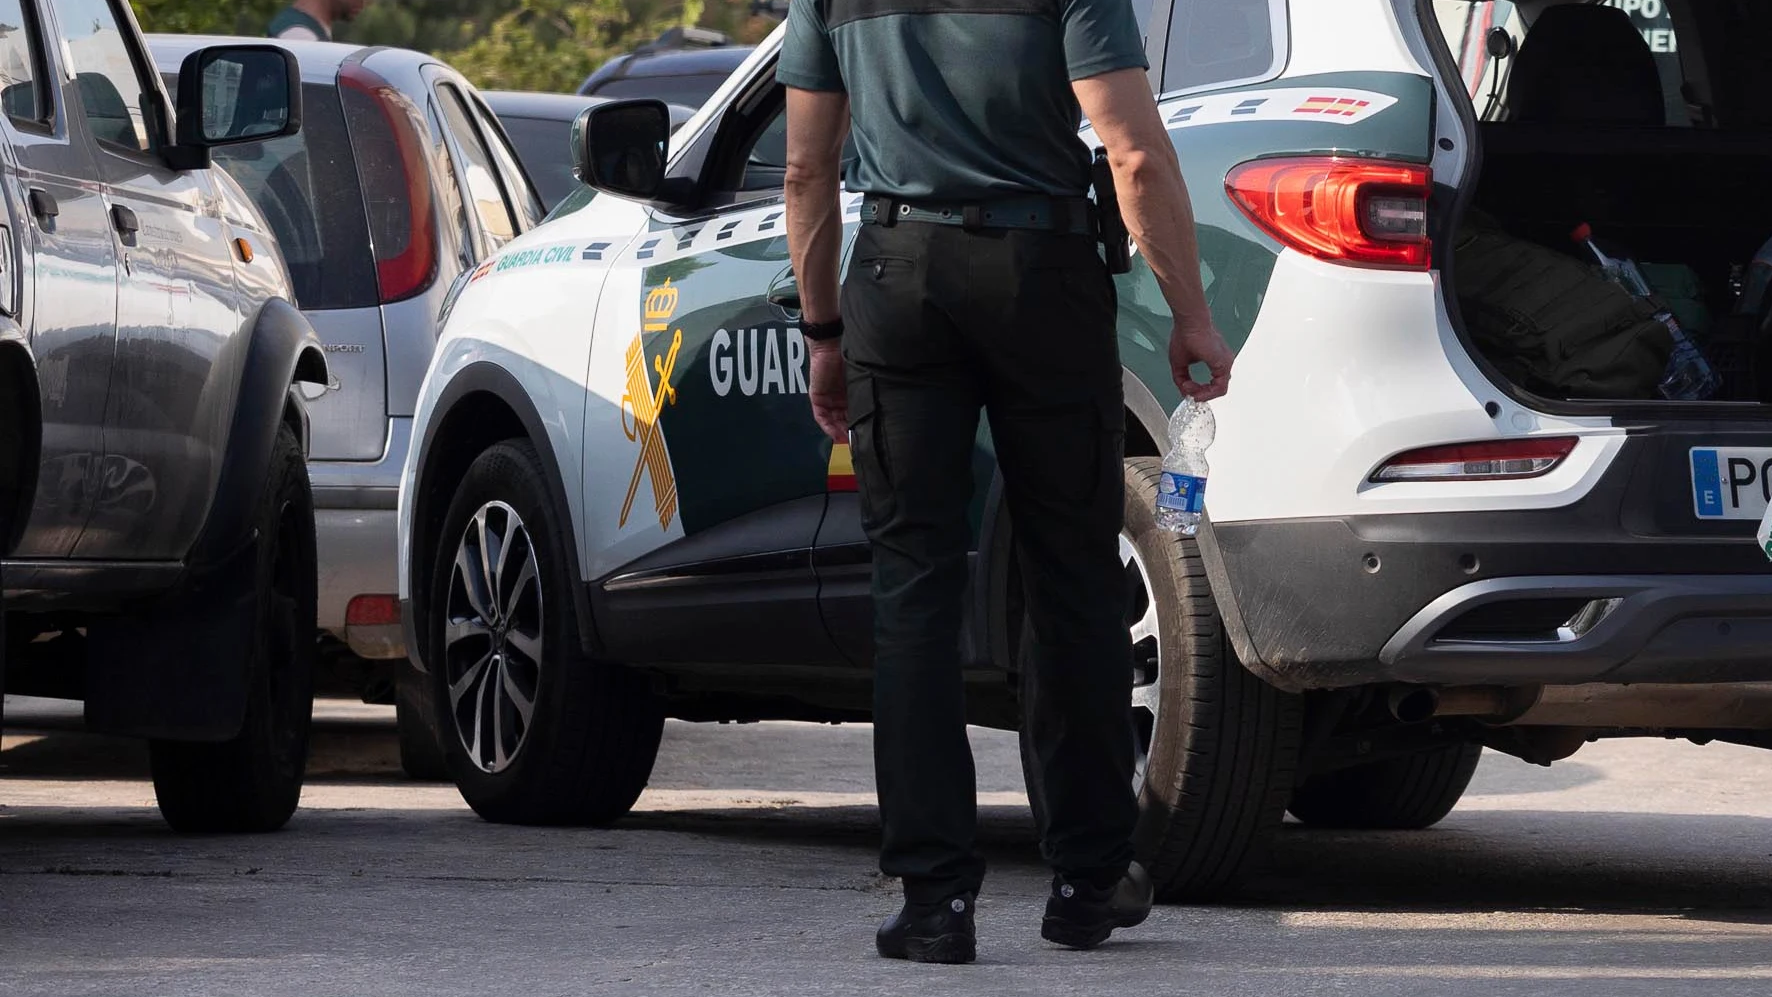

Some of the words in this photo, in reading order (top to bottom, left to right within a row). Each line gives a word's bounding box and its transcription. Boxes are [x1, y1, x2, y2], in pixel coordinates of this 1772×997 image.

[496, 247, 544, 271] GUARDIA
[544, 245, 576, 264] CIVIL
[709, 328, 809, 397] GUAR
[1703, 490, 1715, 505] E
